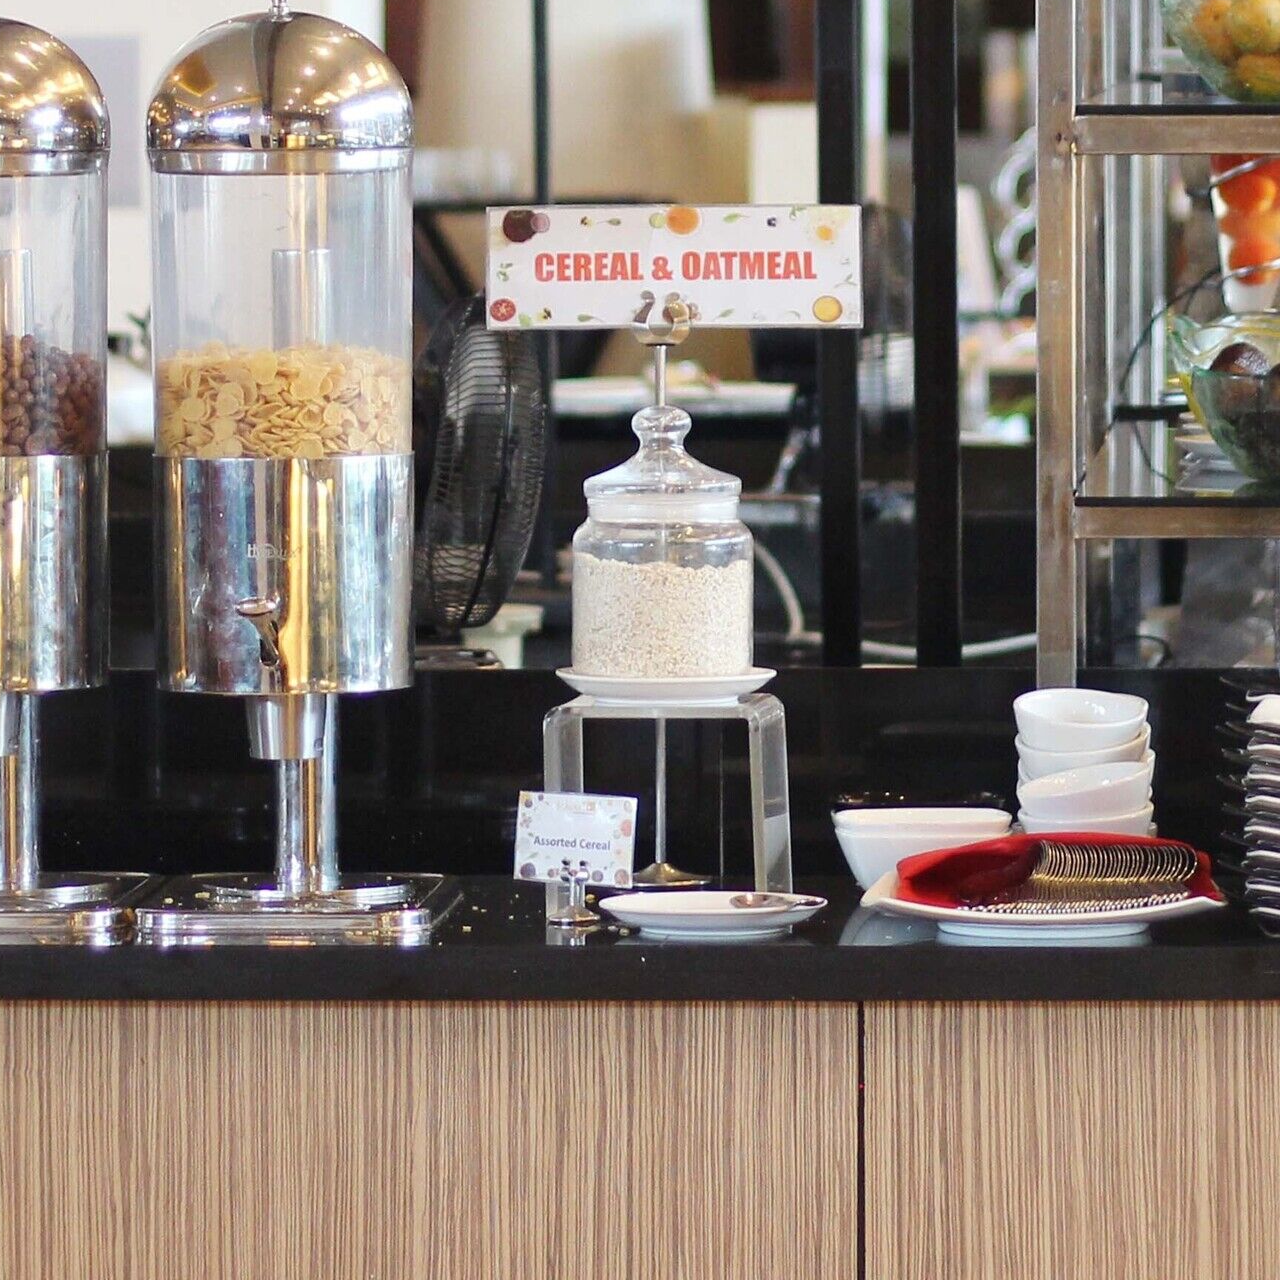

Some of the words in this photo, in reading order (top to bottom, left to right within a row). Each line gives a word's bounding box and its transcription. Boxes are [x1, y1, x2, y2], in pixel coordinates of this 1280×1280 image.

[534, 252, 644, 282] CEREAL
[651, 255, 674, 281] &
[681, 250, 818, 280] OATMEAL
[533, 836, 577, 848] Assorted
[579, 839, 611, 851] Cereal
